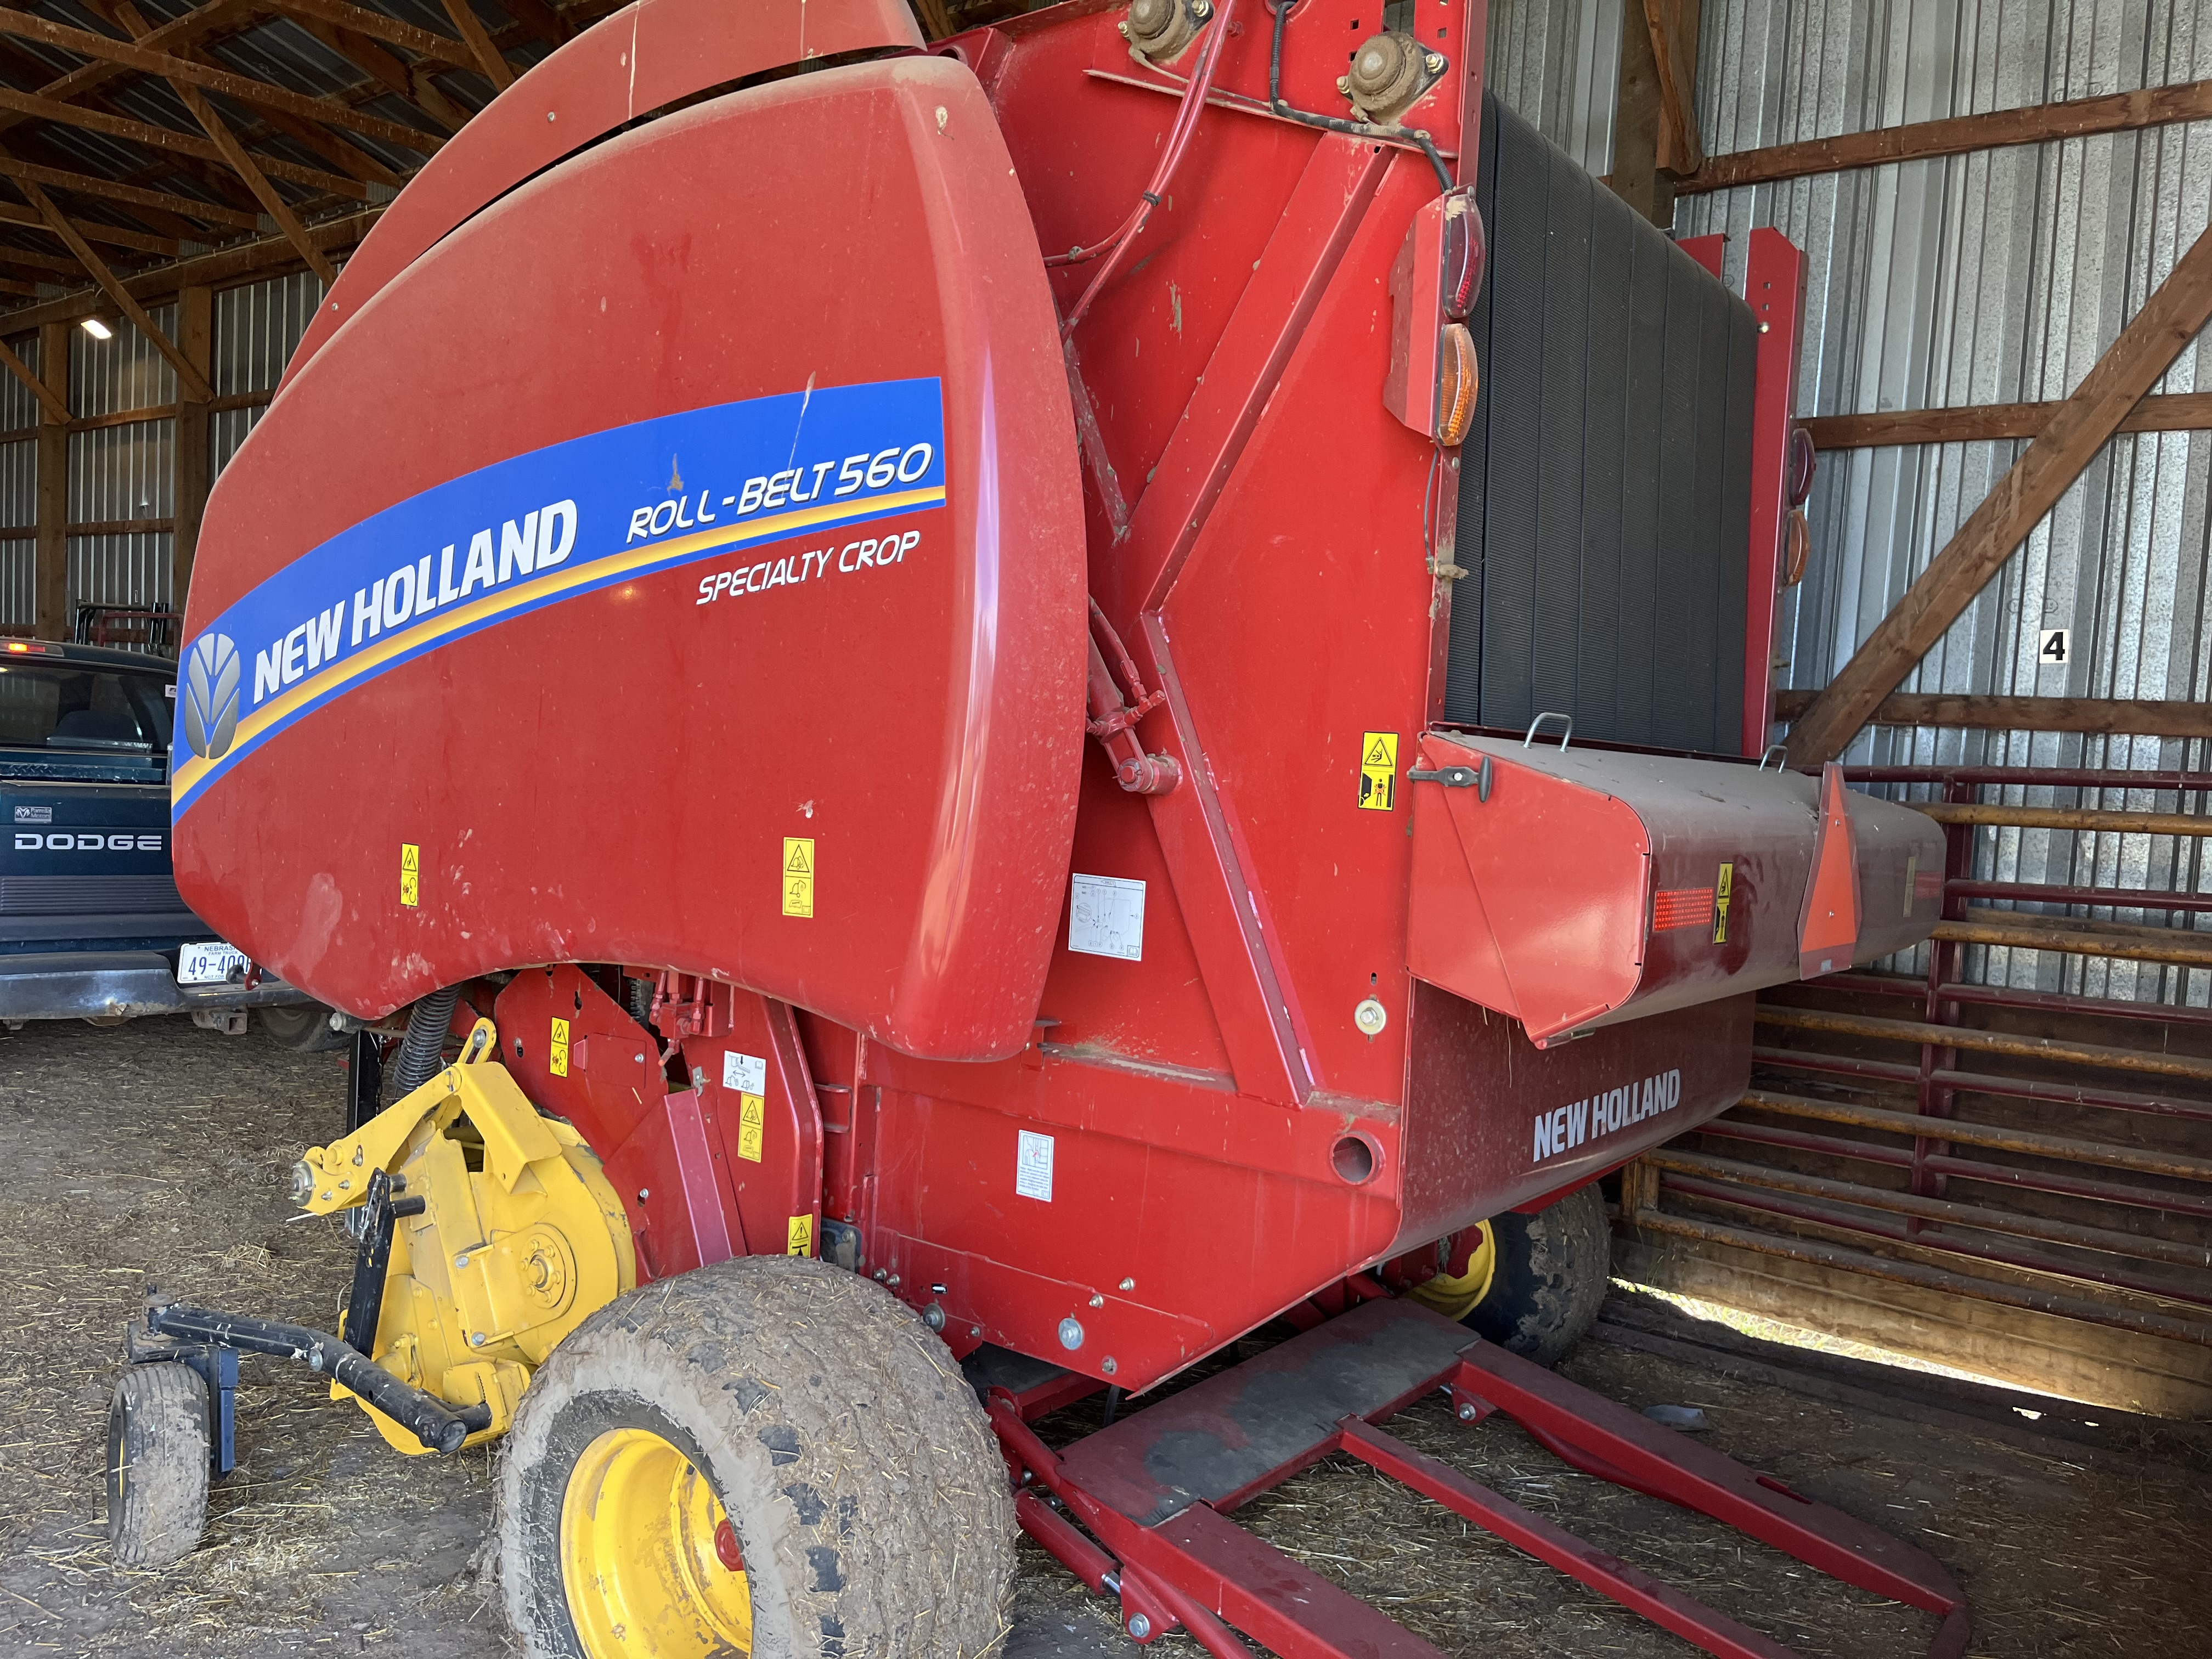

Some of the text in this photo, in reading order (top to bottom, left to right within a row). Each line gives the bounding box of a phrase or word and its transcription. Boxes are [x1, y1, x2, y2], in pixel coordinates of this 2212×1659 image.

[834, 442, 934, 496] 560
[696, 530, 921, 605] SPECIALTY CROP
[253, 499, 578, 705] NEW HOLLAND
[2042, 631, 2066, 661] 4
[14, 833, 162, 850] DODGE
[1533, 1069, 1680, 1163] NEW HOLLAND
